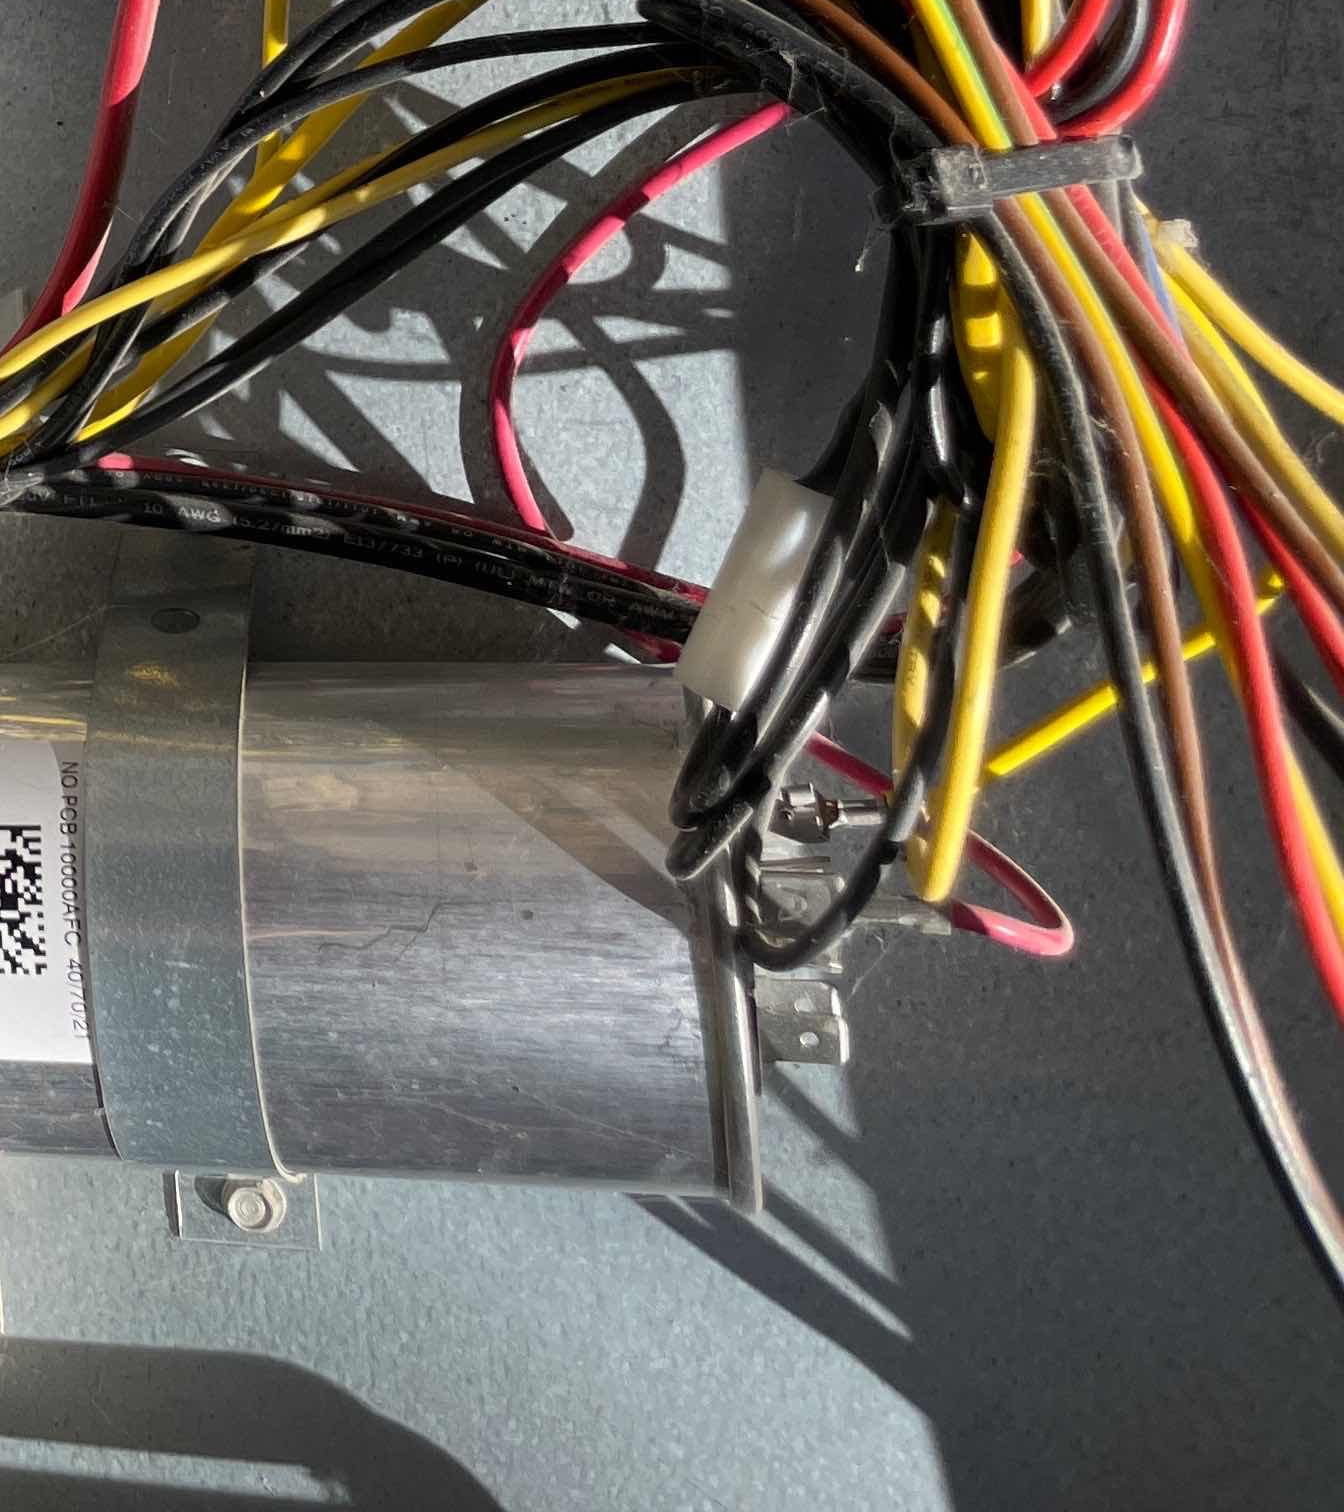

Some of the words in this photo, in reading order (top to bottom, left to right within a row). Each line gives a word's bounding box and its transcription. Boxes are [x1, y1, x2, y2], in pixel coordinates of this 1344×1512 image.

[178, 506, 223, 524] AWG
[60, 761, 79, 789] NO
[59, 795, 78, 835] PCB
[60, 840, 82, 946] 10000AFC
